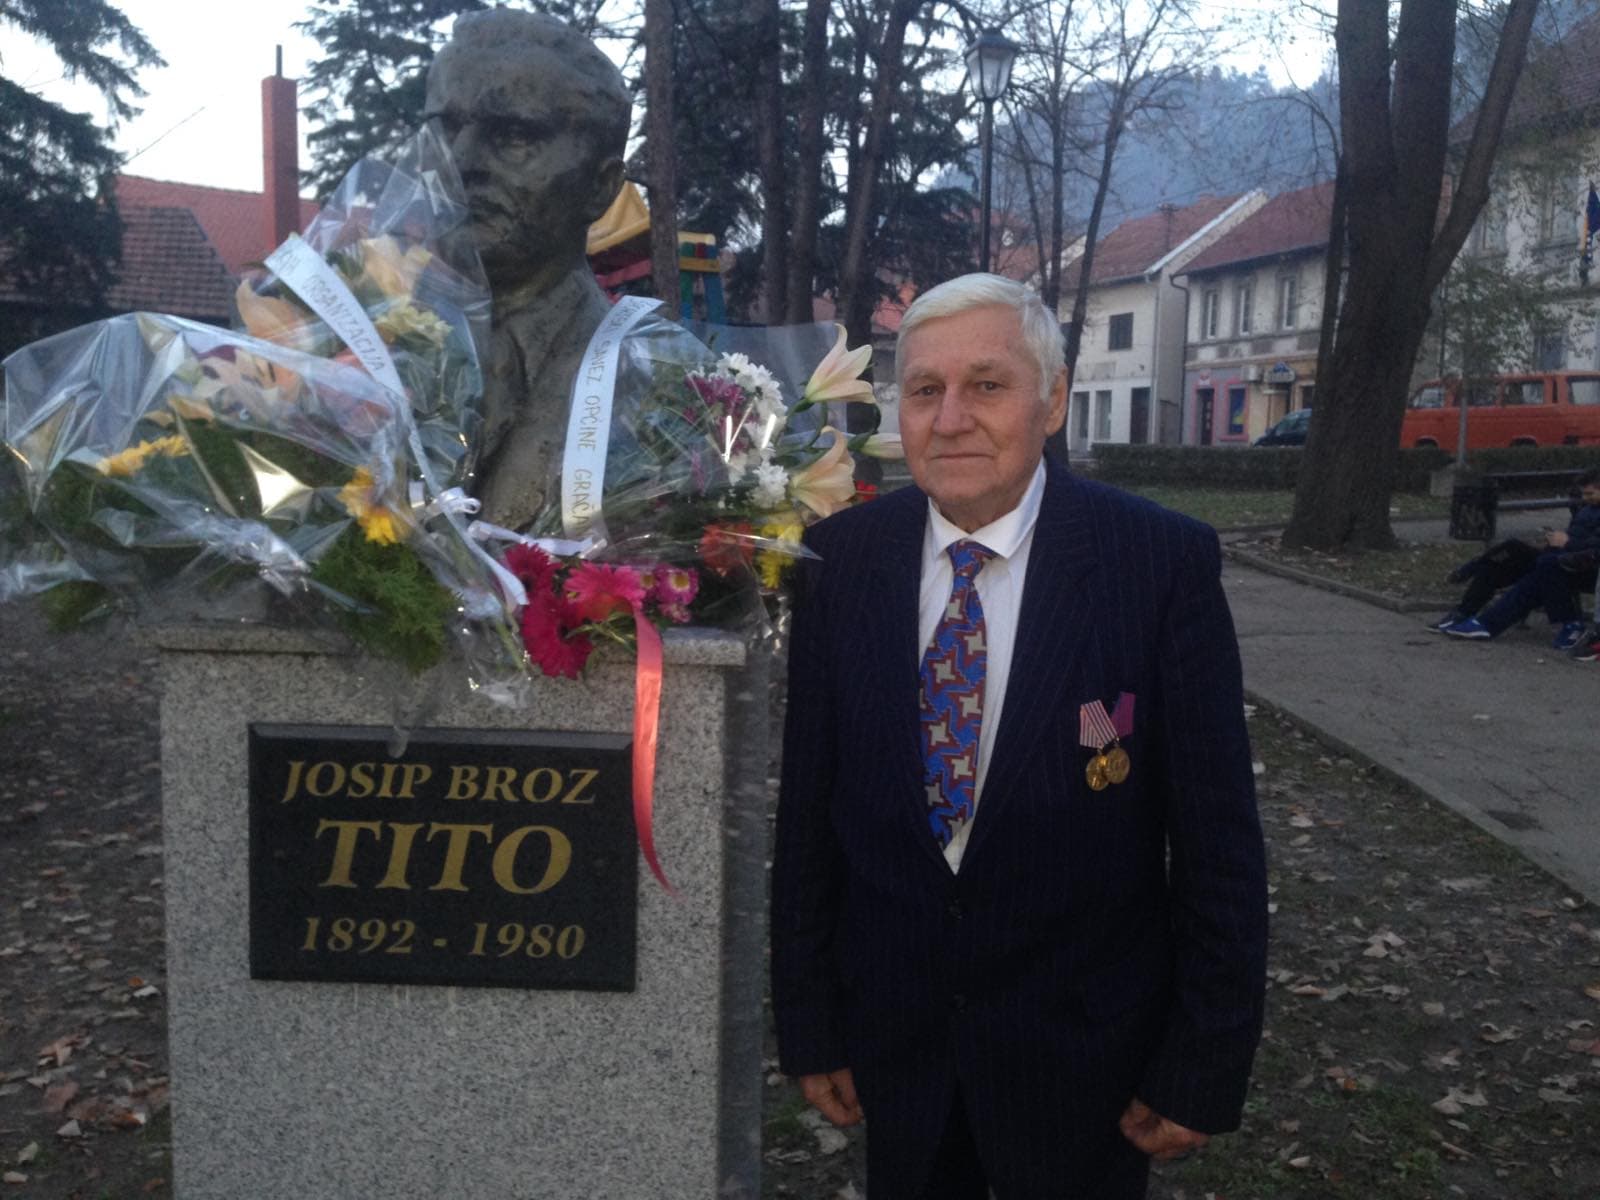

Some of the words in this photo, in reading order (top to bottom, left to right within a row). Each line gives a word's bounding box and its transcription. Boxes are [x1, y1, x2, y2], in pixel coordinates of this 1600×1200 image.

[282, 760, 432, 803] JOSIP
[444, 765, 599, 804] BROZ
[314, 818, 573, 895] TITO
[301, 915, 416, 954] 1892
[468, 921, 586, 959] 1980
